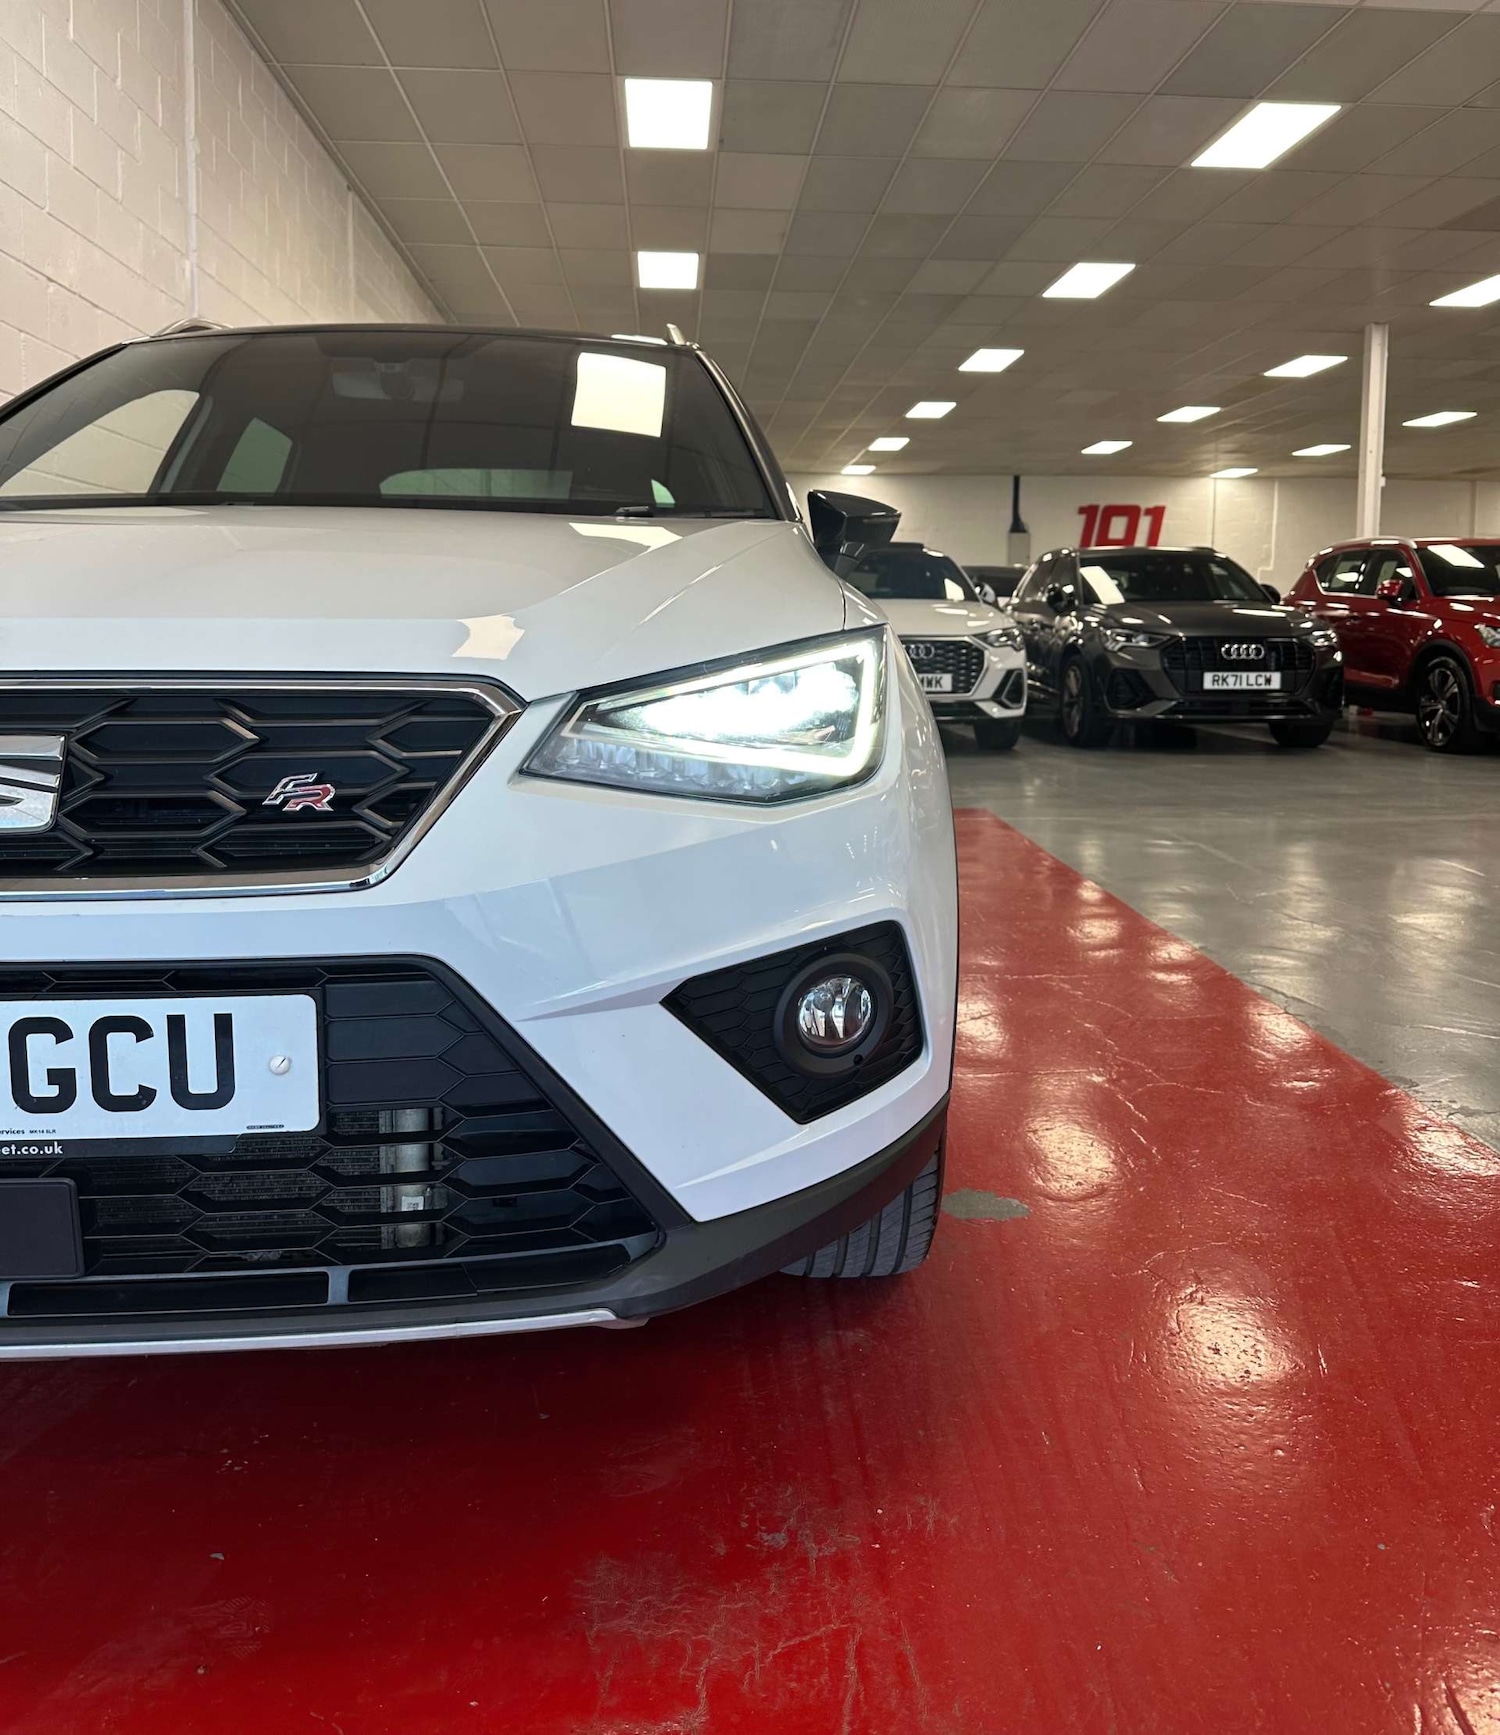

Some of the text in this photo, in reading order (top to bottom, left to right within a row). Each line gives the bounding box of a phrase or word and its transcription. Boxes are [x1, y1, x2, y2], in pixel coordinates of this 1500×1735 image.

[1077, 504, 1166, 547] 101
[1212, 674, 1272, 687] RK71 LCW
[262, 772, 336, 812] FR
[8, 1013, 236, 1114] GCU
